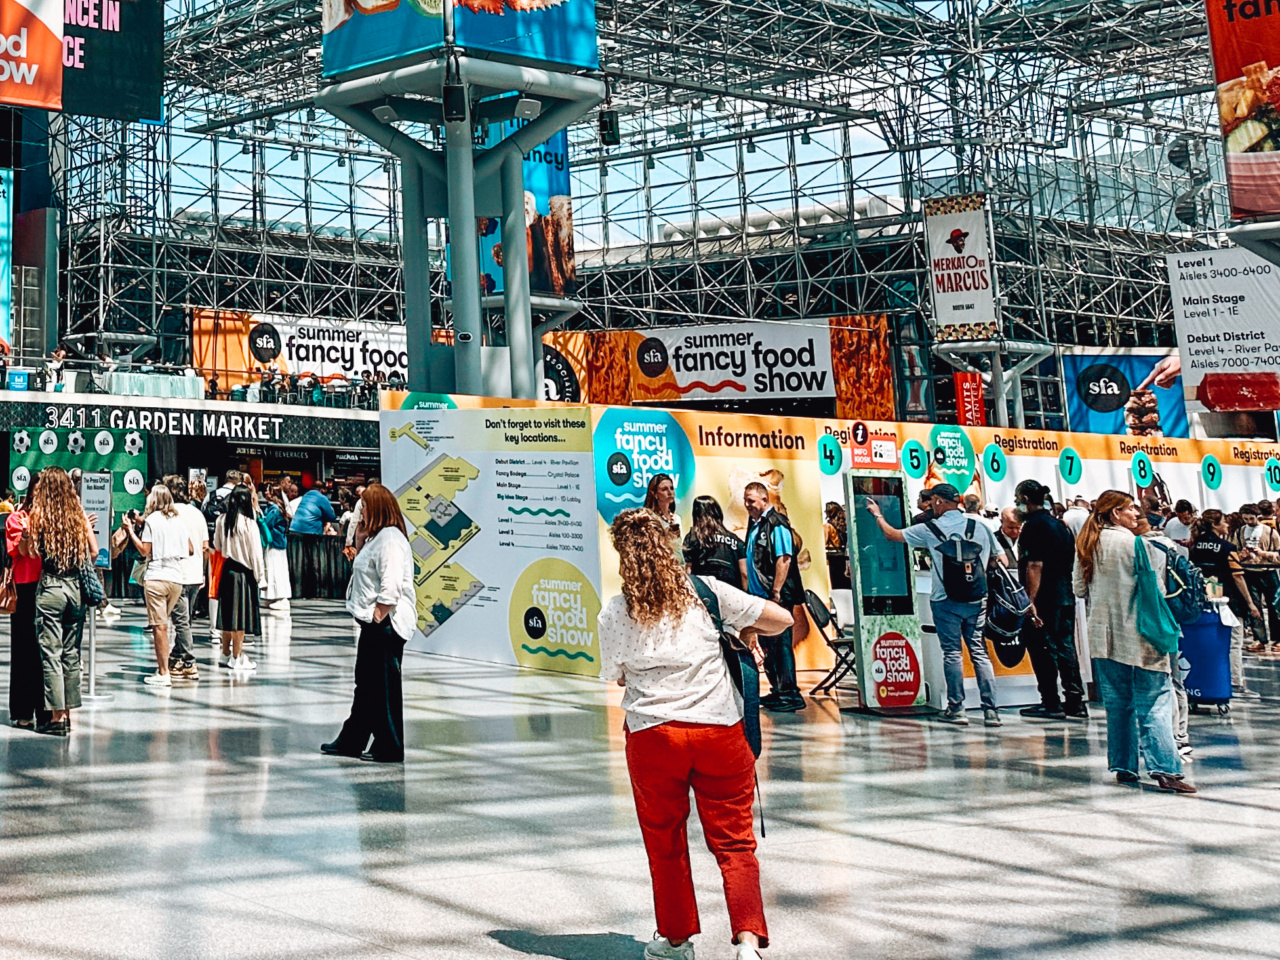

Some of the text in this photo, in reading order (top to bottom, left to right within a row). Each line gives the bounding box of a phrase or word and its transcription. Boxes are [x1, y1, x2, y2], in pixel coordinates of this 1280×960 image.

[523, 150, 564, 171] ancy
[933, 254, 978, 272] MERKATO
[1177, 257, 1214, 269] Level 1
[1180, 264, 1271, 281] Aisles 3400-6400
[935, 269, 989, 294] MARCUS
[1182, 294, 1246, 306] Main Stage
[1184, 306, 1239, 319] Level 1 1E
[255, 334, 275, 350] sfa
[297, 326, 362, 344] summer
[683, 330, 754, 349] summer
[1187, 330, 1266, 344] Debut District
[286, 336, 355, 372] fancy
[643, 352, 662, 364] sfa
[672, 339, 815, 377] fancy food
[1188, 343, 1261, 356] Level 4 River
[1190, 358, 1220, 369] Aisles
[753, 364, 828, 393] show
[1088, 378, 1121, 396] sfa
[418, 401, 449, 409] summer
[962, 382, 974, 426] JAVITS
[45, 406, 284, 440] 3411 GARDEN MARKET
[485, 418, 586, 431] Don't forget to visit these
[623, 421, 667, 434] summer
[43, 437, 54, 446] sfa
[98, 438, 110, 446] sfa
[504, 433, 520, 445] key
[615, 428, 667, 456] fancy
[698, 425, 805, 451] Information
[936, 434, 962, 451] fancy
[993, 434, 1059, 452] Registration
[822, 443, 835, 466] 4
[853, 448, 868, 456] INFO
[945, 446, 965, 458] food
[1119, 441, 1179, 457] Registration
[1233, 446, 1280, 463] Registratio
[612, 461, 628, 474] sfa
[632, 449, 673, 471] food
[853, 455, 872, 464] KIOSK
[909, 448, 921, 470] 5
[946, 456, 968, 467] show
[990, 452, 1001, 473] 6
[1065, 456, 1075, 477] 7
[16, 473, 27, 482] sfa
[633, 467, 680, 488] shw
[1137, 459, 1147, 480] 8
[1207, 463, 1216, 482] 9
[128, 474, 140, 485] sfa
[1196, 541, 1221, 553] ancy
[539, 579, 582, 591] summer
[531, 584, 582, 614] fancy
[528, 616, 542, 628] sfa
[547, 605, 587, 628] food
[547, 624, 594, 647] show
[875, 644, 907, 661] fancy
[886, 656, 910, 671] food
[886, 670, 914, 683] show
